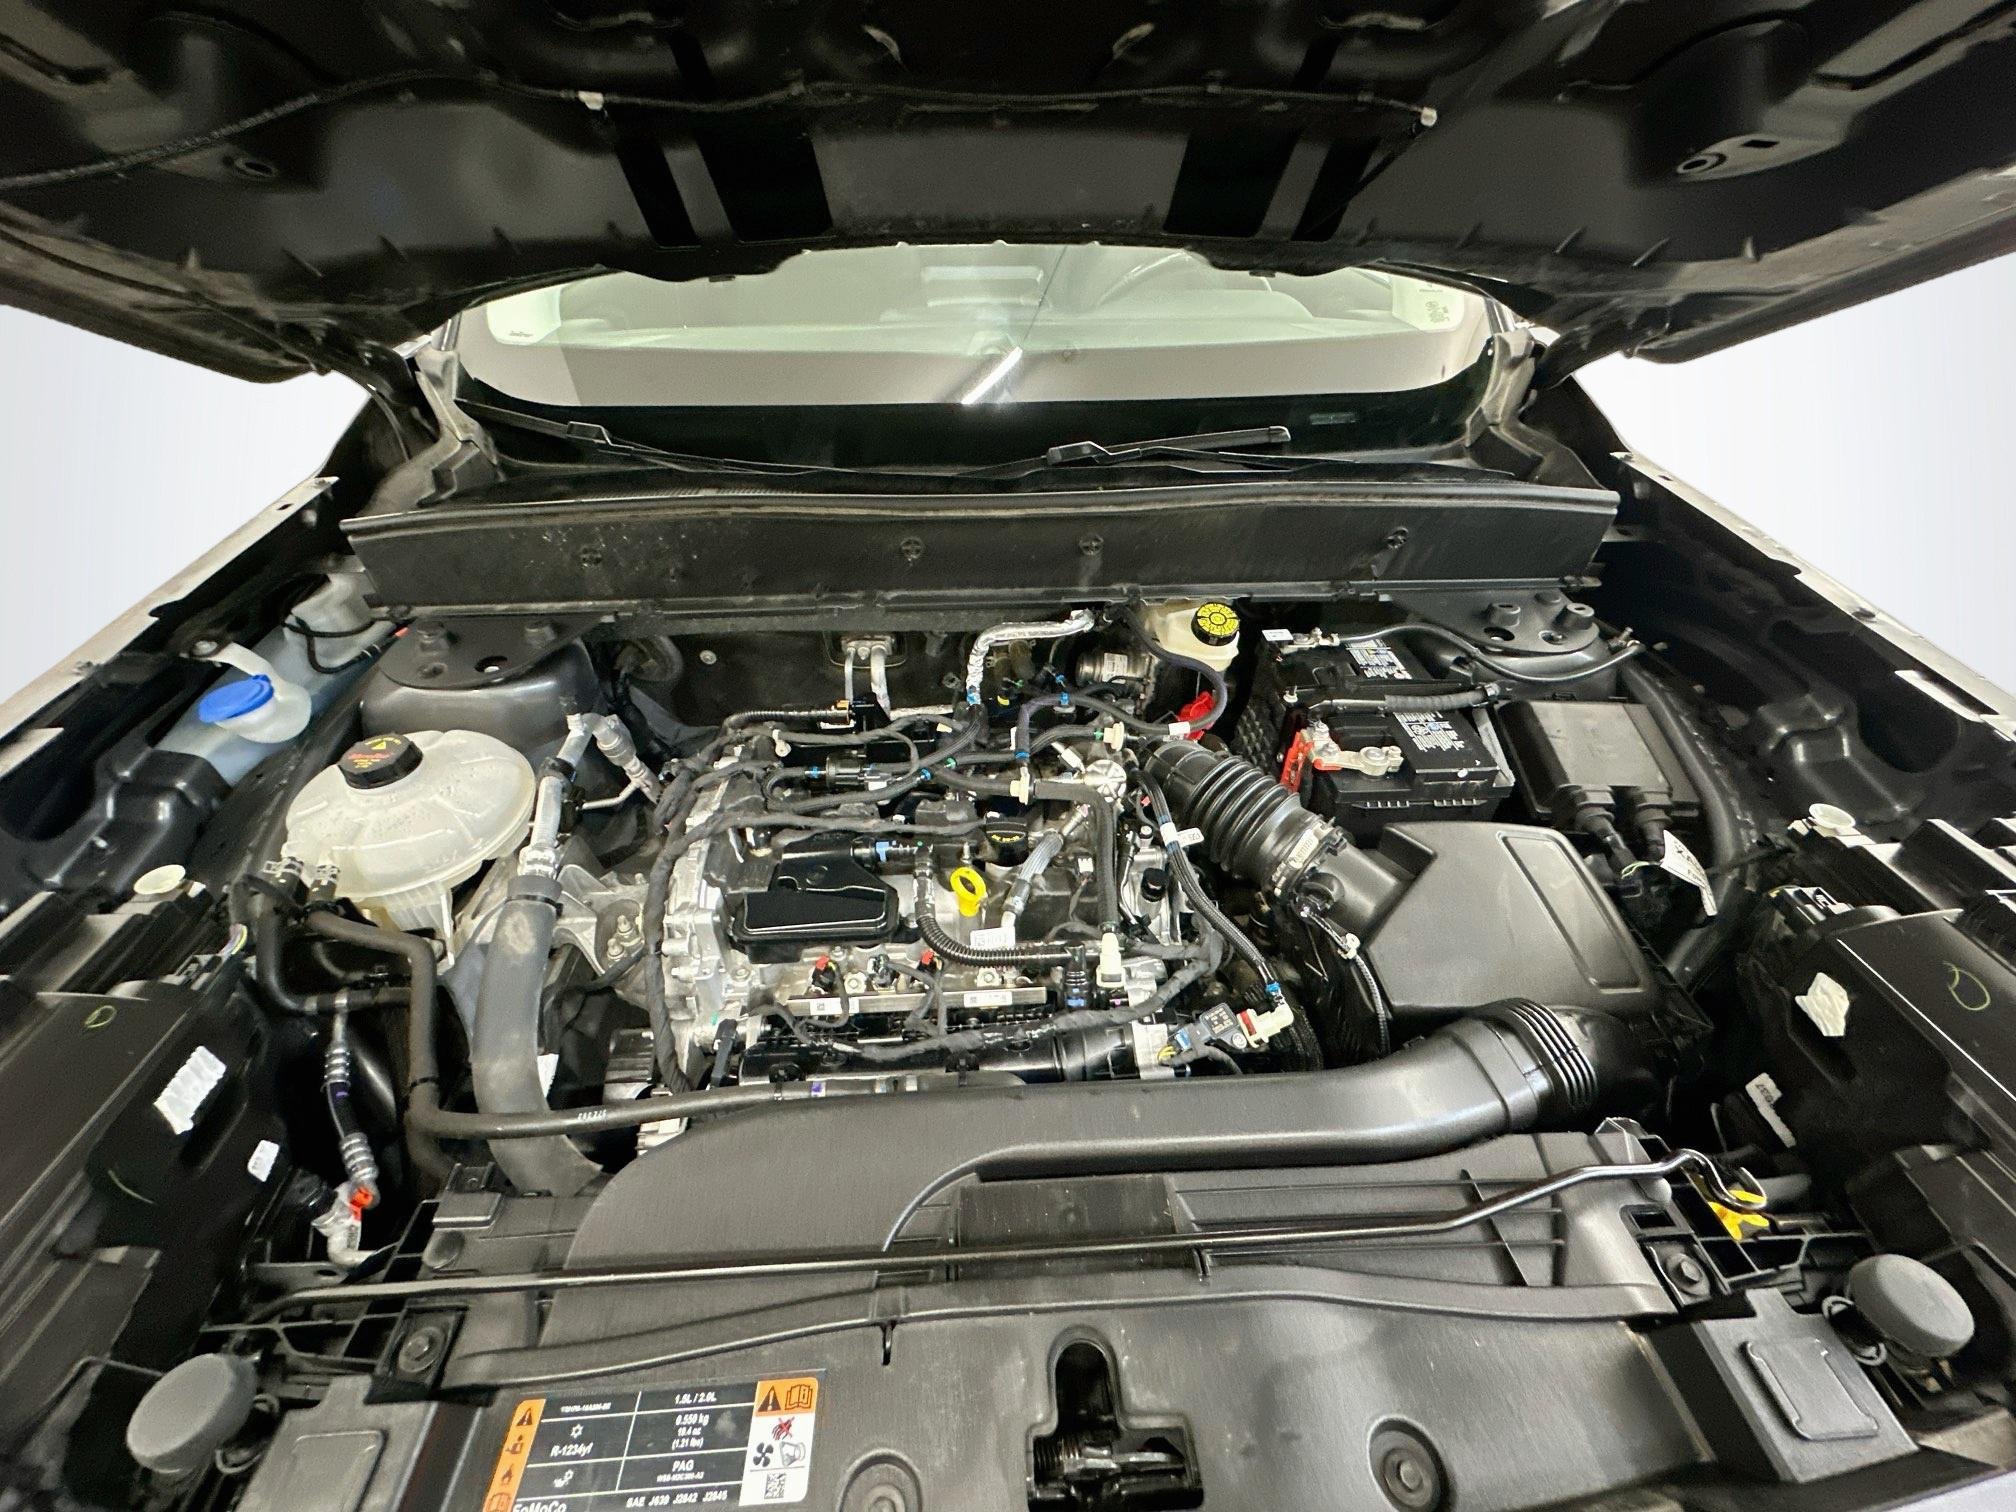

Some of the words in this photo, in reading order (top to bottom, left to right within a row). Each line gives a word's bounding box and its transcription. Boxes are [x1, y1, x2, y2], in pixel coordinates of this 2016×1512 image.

[550, 1441, 594, 1458] R-1234yf
[672, 1459, 694, 1472] PAG
[626, 1496, 646, 1508] SAE
